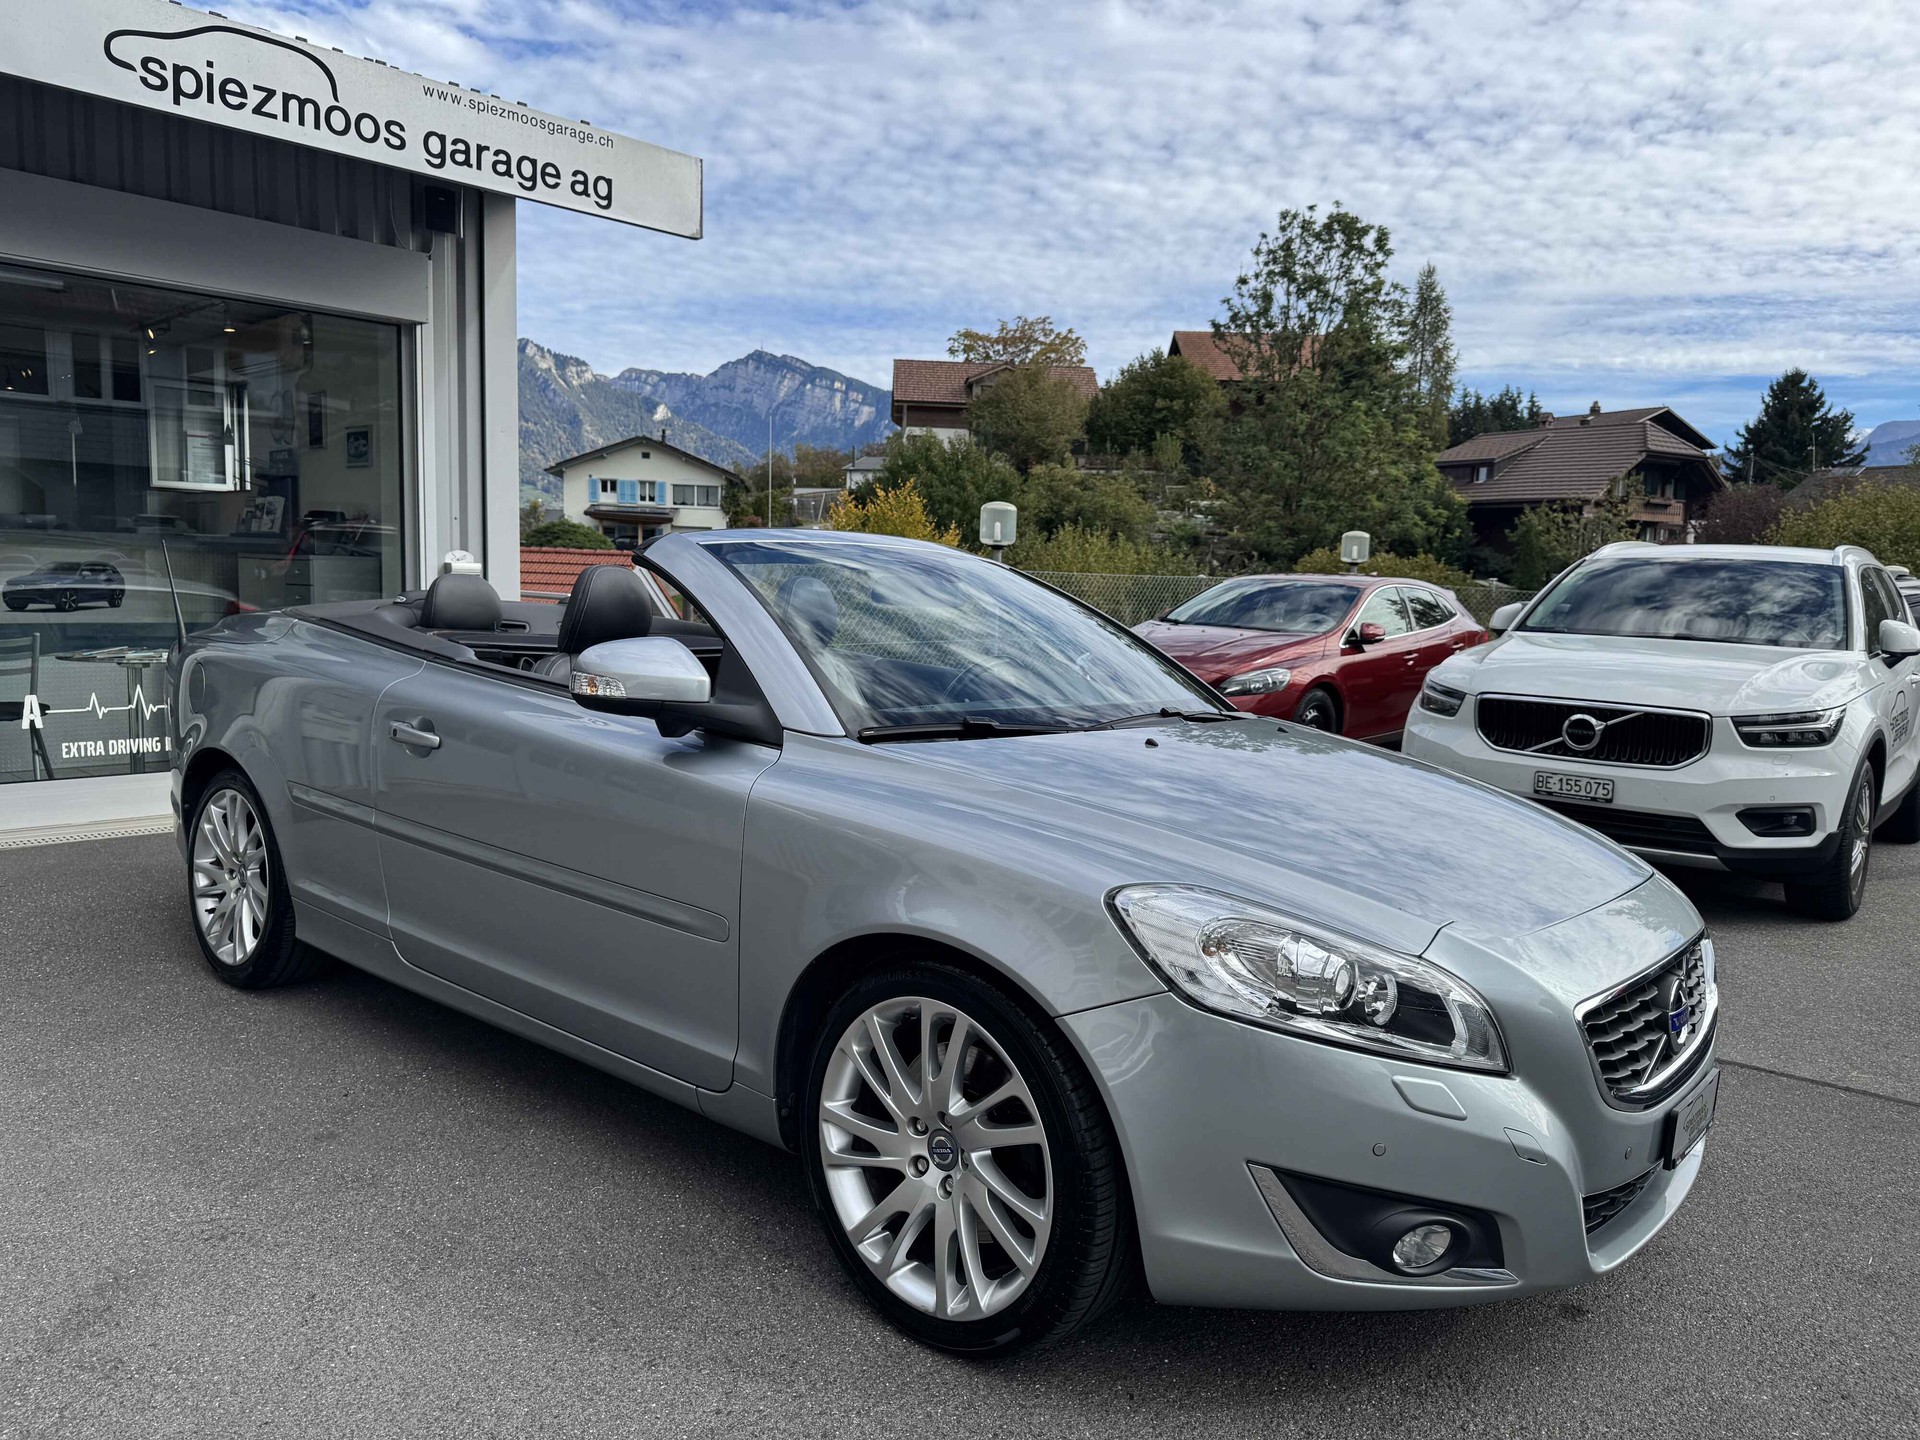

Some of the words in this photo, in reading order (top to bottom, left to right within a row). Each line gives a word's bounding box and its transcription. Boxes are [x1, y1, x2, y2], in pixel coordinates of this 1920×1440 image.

[138, 56, 407, 151] spiezmoos
[422, 130, 561, 191] garage
[569, 169, 613, 210] ag
[422, 85, 614, 149] www.spiezmoosgarage.ch
[61, 740, 105, 759] EXTRA
[108, 736, 162, 755] DRIVING
